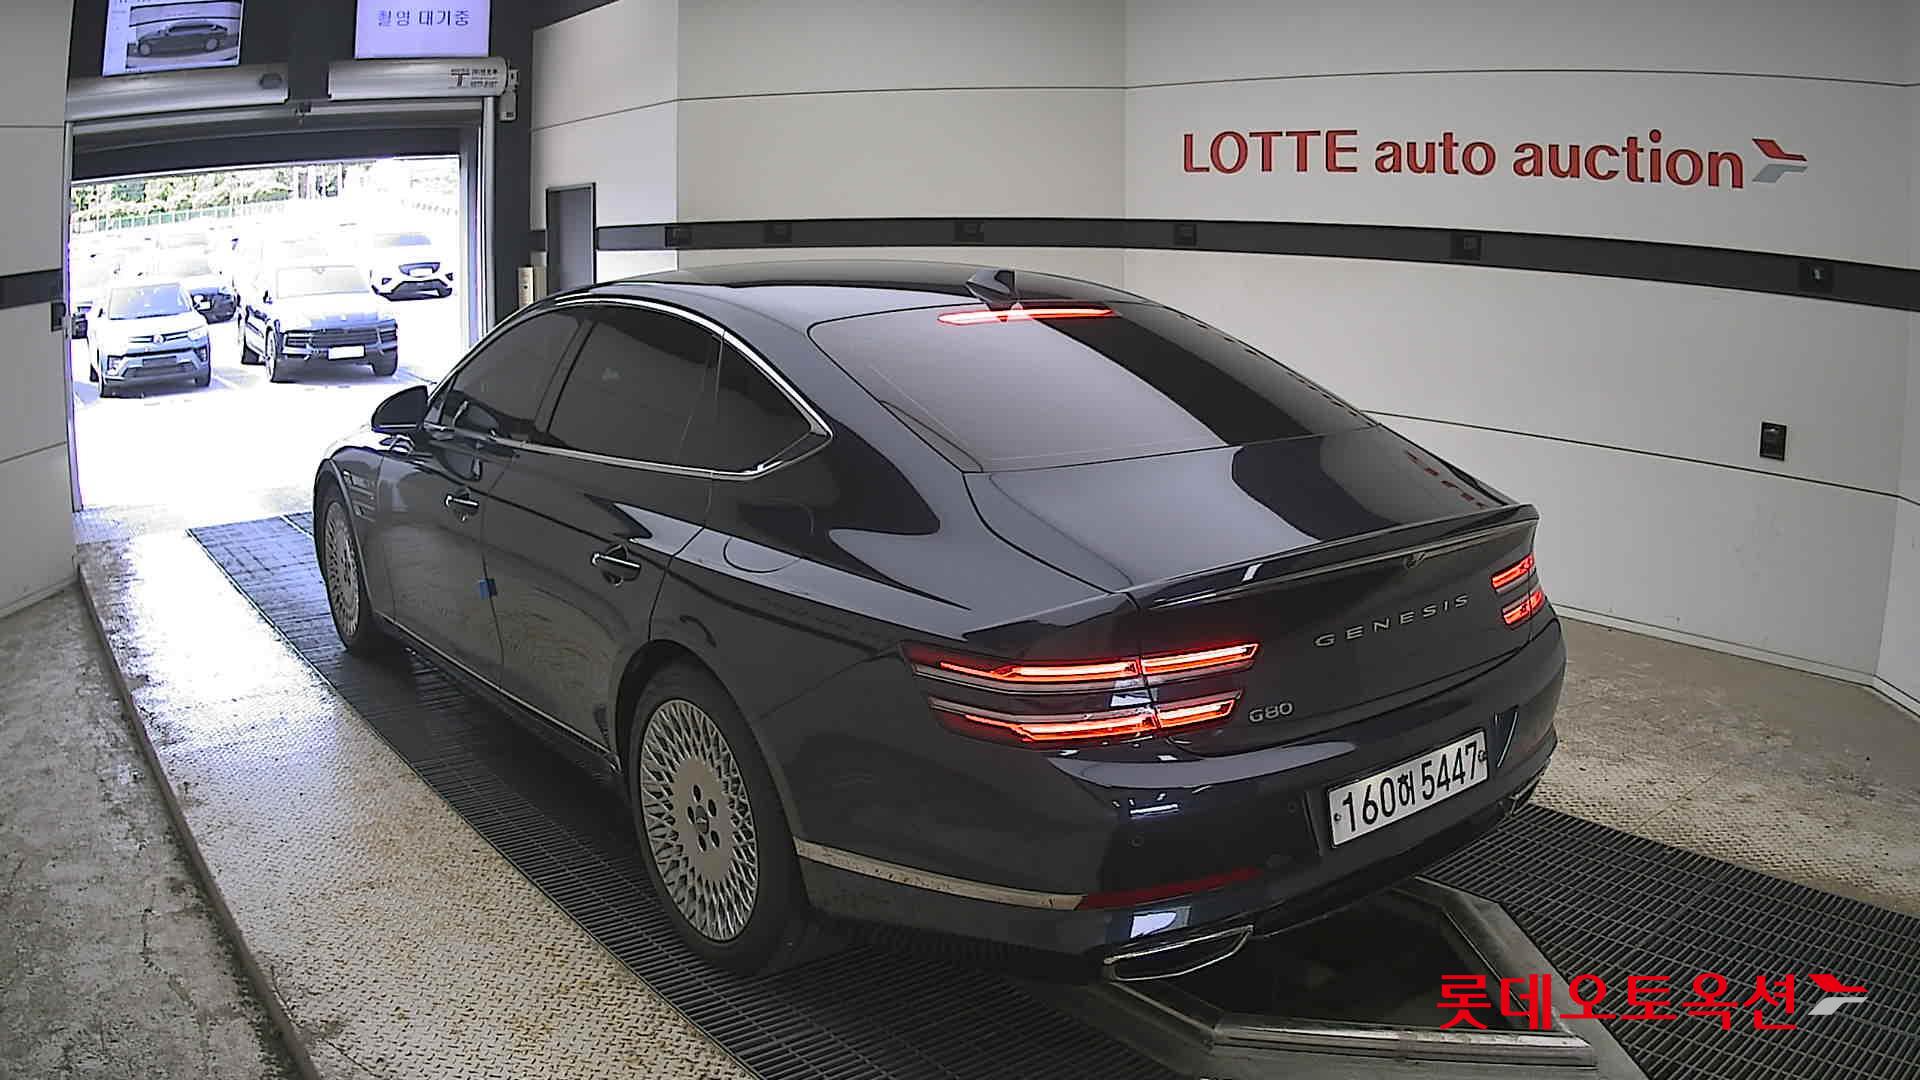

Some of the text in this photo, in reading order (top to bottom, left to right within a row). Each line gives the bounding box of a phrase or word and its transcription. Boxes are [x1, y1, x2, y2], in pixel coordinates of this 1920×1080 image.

[418, 9, 470, 26] 대기중
[1183, 129, 1745, 189] LOTTE auto auction
[1314, 594, 1471, 647] GENESIS
[1249, 701, 1294, 723] G80
[1341, 740, 1479, 833] 160허 5447
